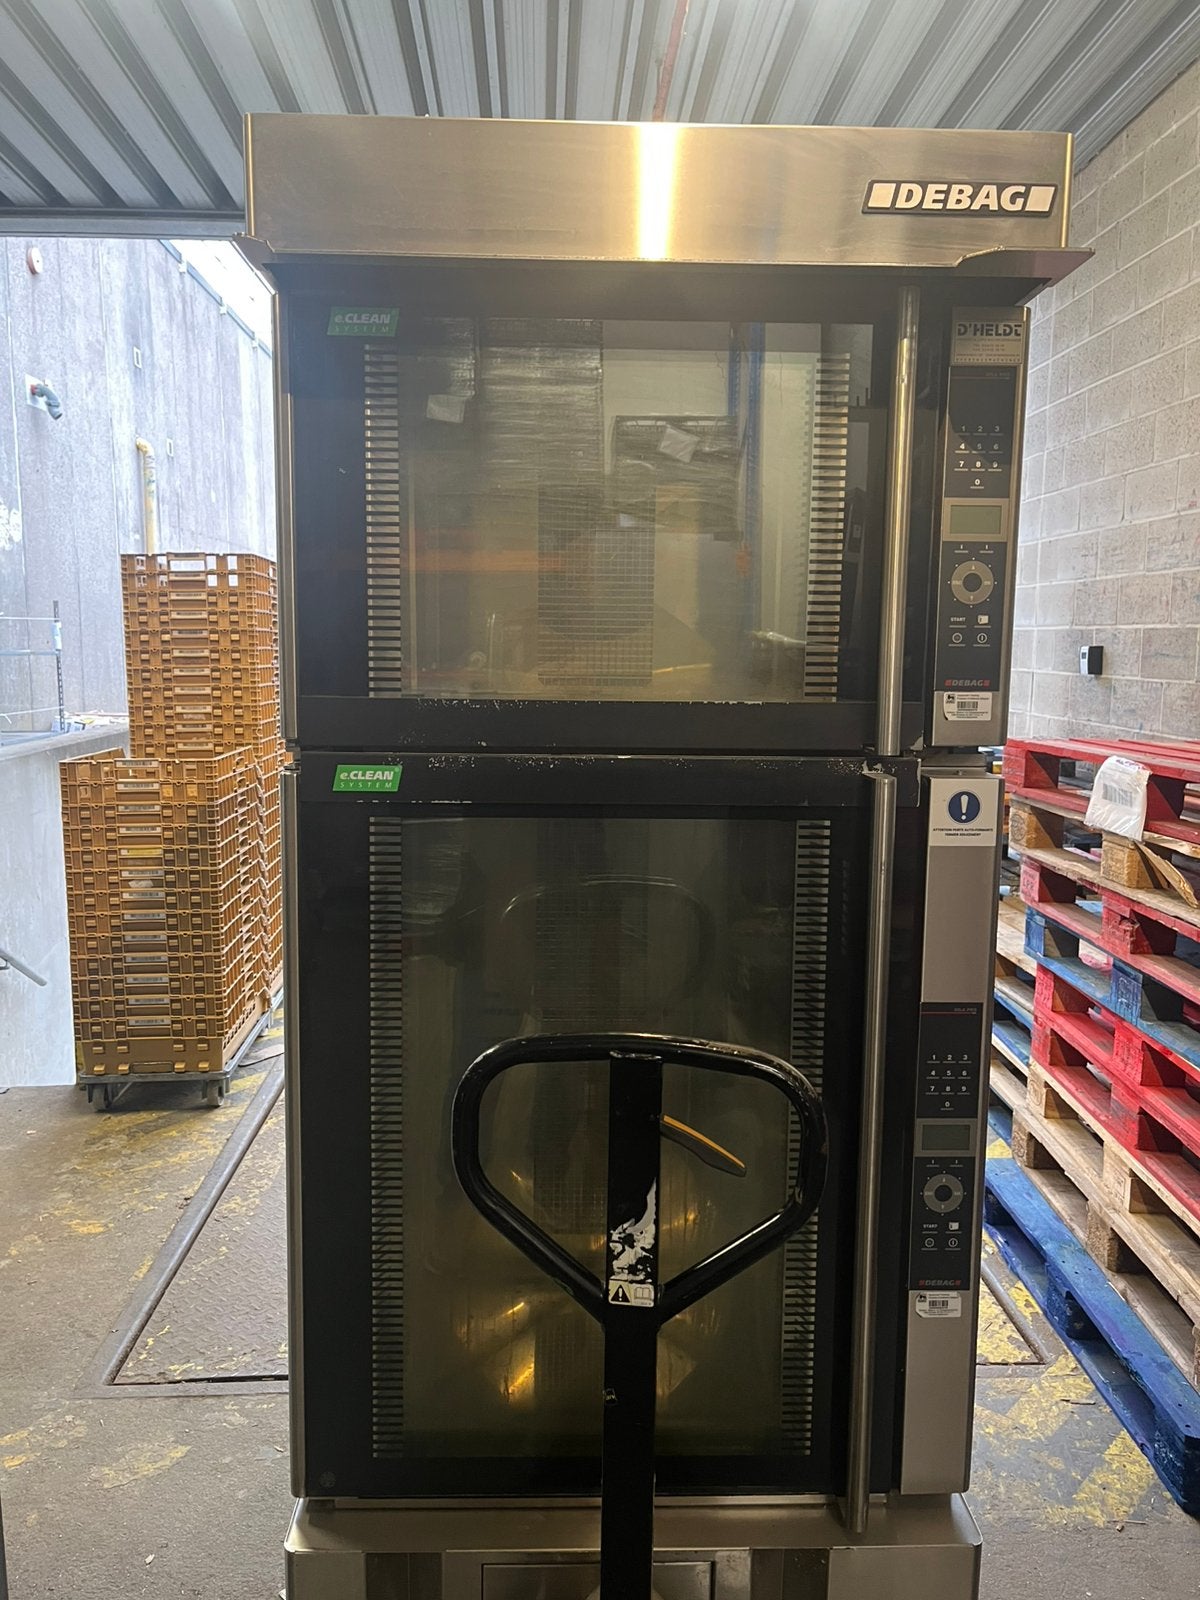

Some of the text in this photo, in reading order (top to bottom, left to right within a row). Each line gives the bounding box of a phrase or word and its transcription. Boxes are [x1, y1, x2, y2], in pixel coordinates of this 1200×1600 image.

[895, 182, 1026, 212] DEBAG
[957, 323, 1022, 337] D'HELDT
[952, 679, 983, 687] DEBAG
